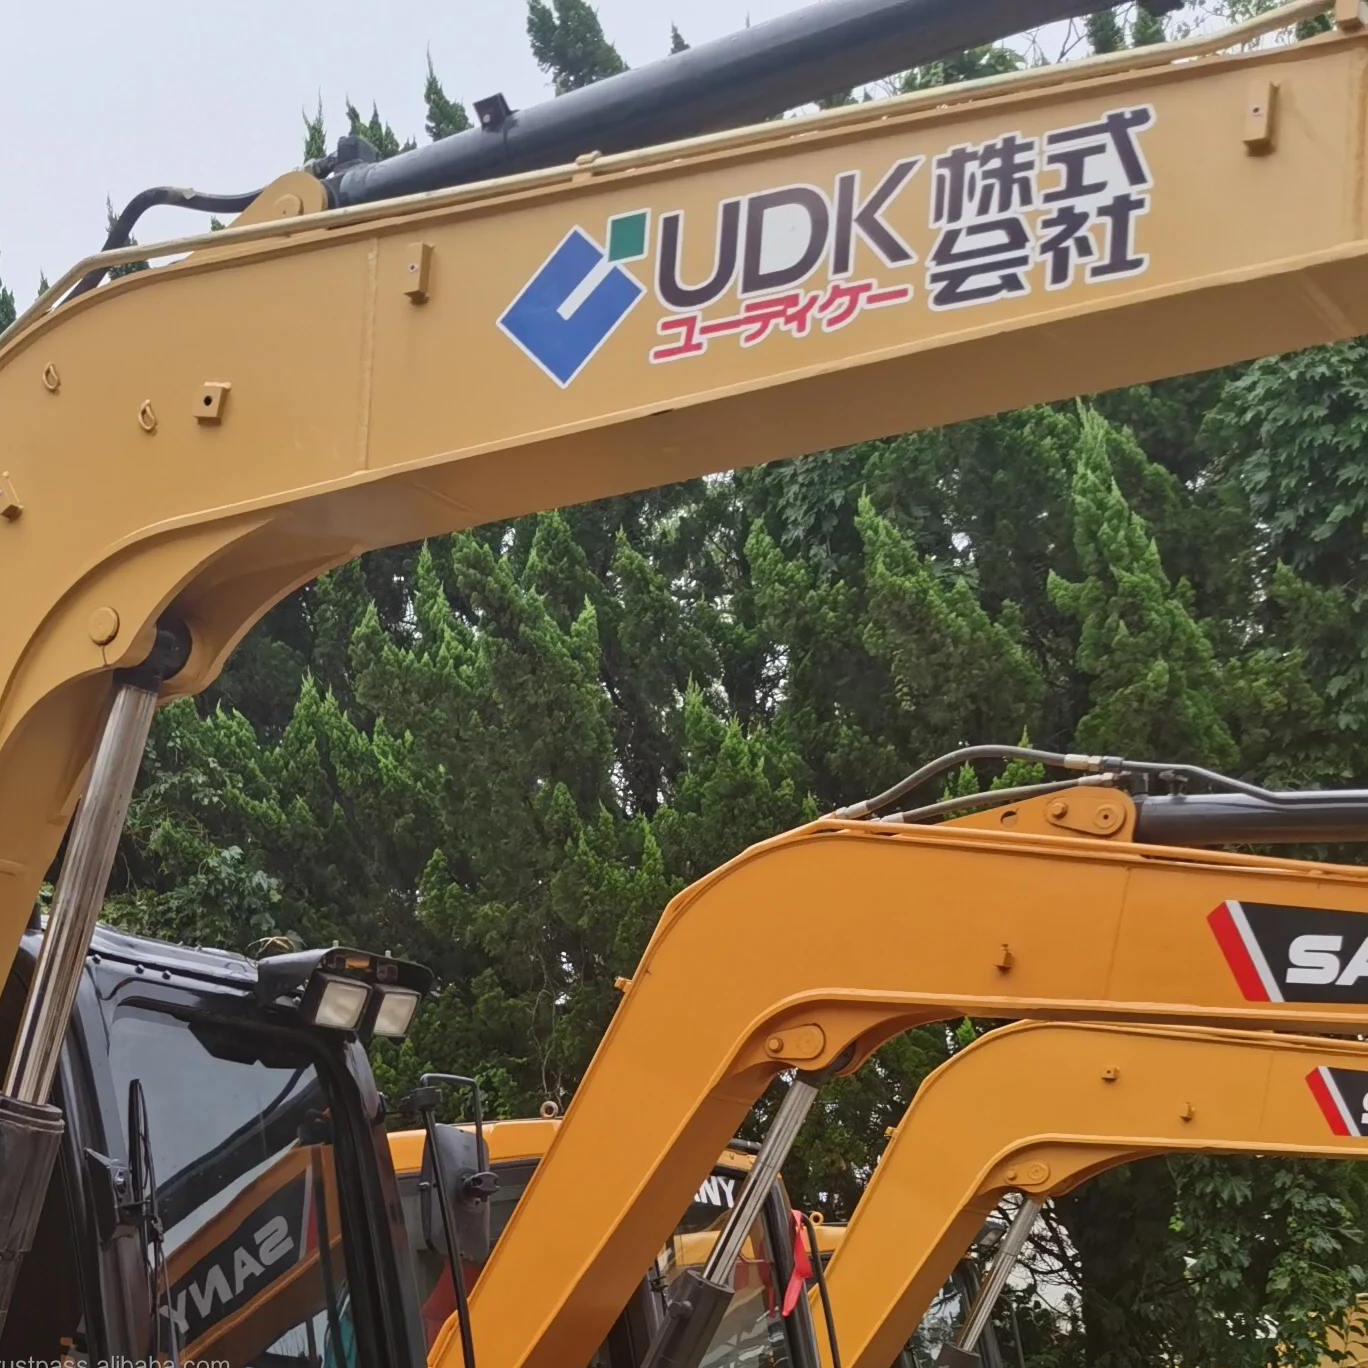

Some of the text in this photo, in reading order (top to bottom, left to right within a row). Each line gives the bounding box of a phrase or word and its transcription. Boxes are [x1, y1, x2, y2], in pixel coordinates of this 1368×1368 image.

[932, 107, 1151, 224] 株式
[658, 155, 924, 308] UDK
[929, 193, 1146, 306] 会社
[653, 282, 909, 360] ユーディケー
